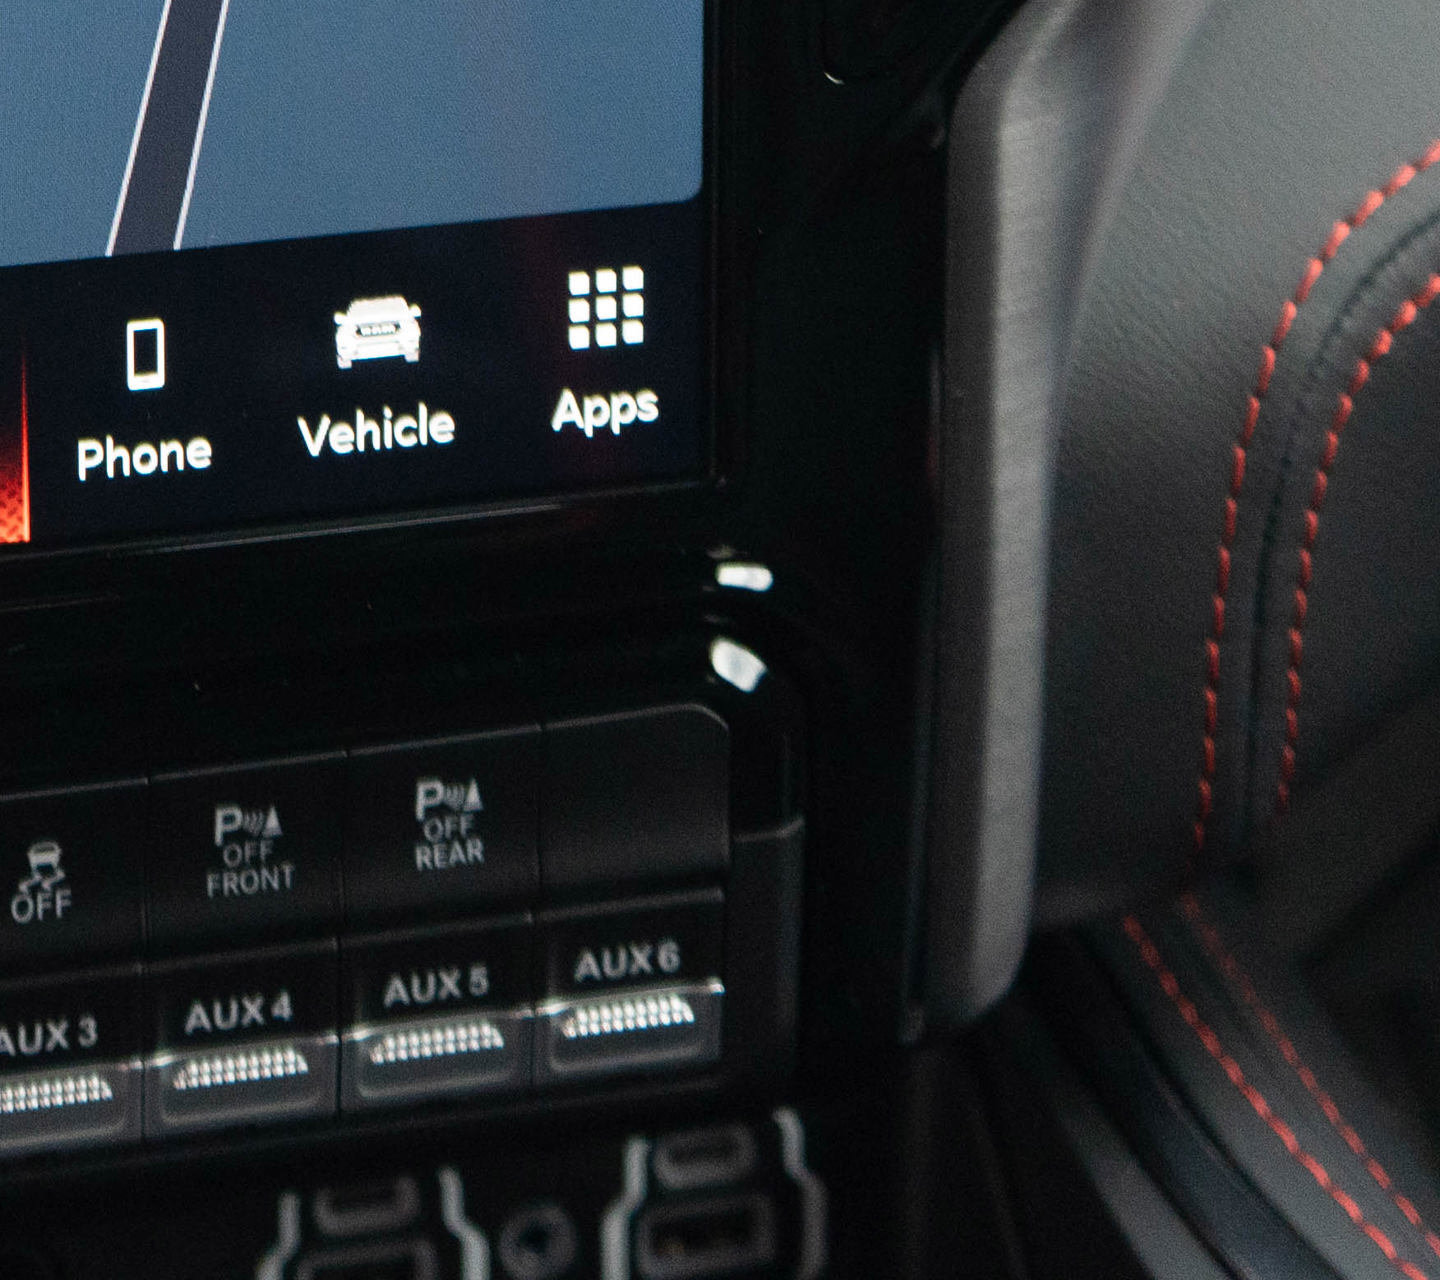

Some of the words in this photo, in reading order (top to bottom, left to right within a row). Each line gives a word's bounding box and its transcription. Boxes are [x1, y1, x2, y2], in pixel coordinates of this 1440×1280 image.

[298, 404, 456, 459] Vehicle
[551, 388, 660, 439] Apps
[77, 436, 213, 481] Phone
[423, 814, 473, 842] OFF
[223, 841, 276, 868] OFF
[416, 839, 484, 871] REAR
[206, 863, 295, 898] FRONT
[11, 890, 73, 924] OFF
[574, 946, 654, 984] AUX
[658, 940, 681, 973] 6
[384, 972, 464, 1008] AUX
[469, 966, 490, 997] 5
[185, 996, 267, 1035] AUX
[270, 990, 294, 1022] 4
[79, 1017, 99, 1047] 3
